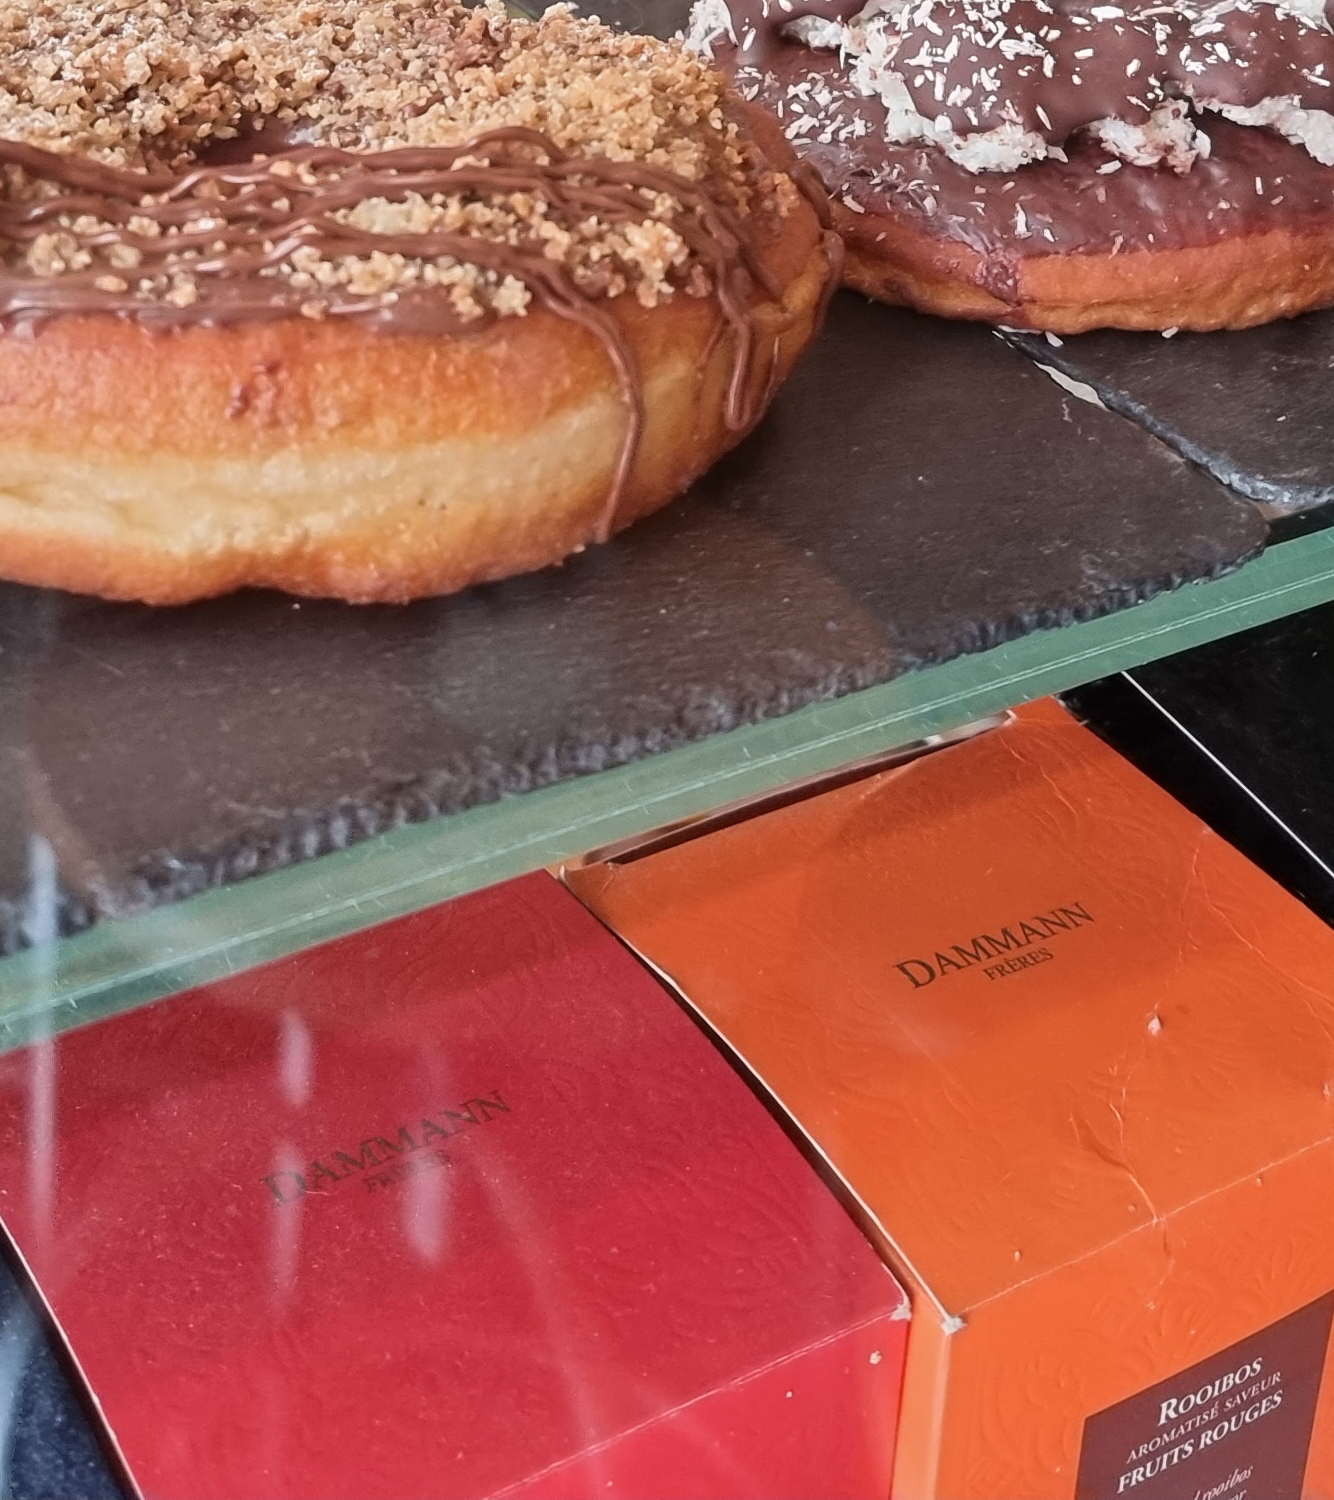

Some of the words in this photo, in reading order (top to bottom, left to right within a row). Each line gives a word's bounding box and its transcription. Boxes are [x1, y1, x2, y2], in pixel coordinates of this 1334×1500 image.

[893, 901, 1096, 989] DAMMANN
[982, 946, 1055, 981] FRÈRES
[258, 1088, 512, 1204] DAMMANN
[1125, 1401, 1220, 1465] AROMATISÉ
[1222, 1371, 1282, 1414] SAVEUR
[1156, 1356, 1264, 1427] ROOIBOS
[1116, 1438, 1195, 1495] FRUITS
[1198, 1389, 1284, 1450] ROUGES
